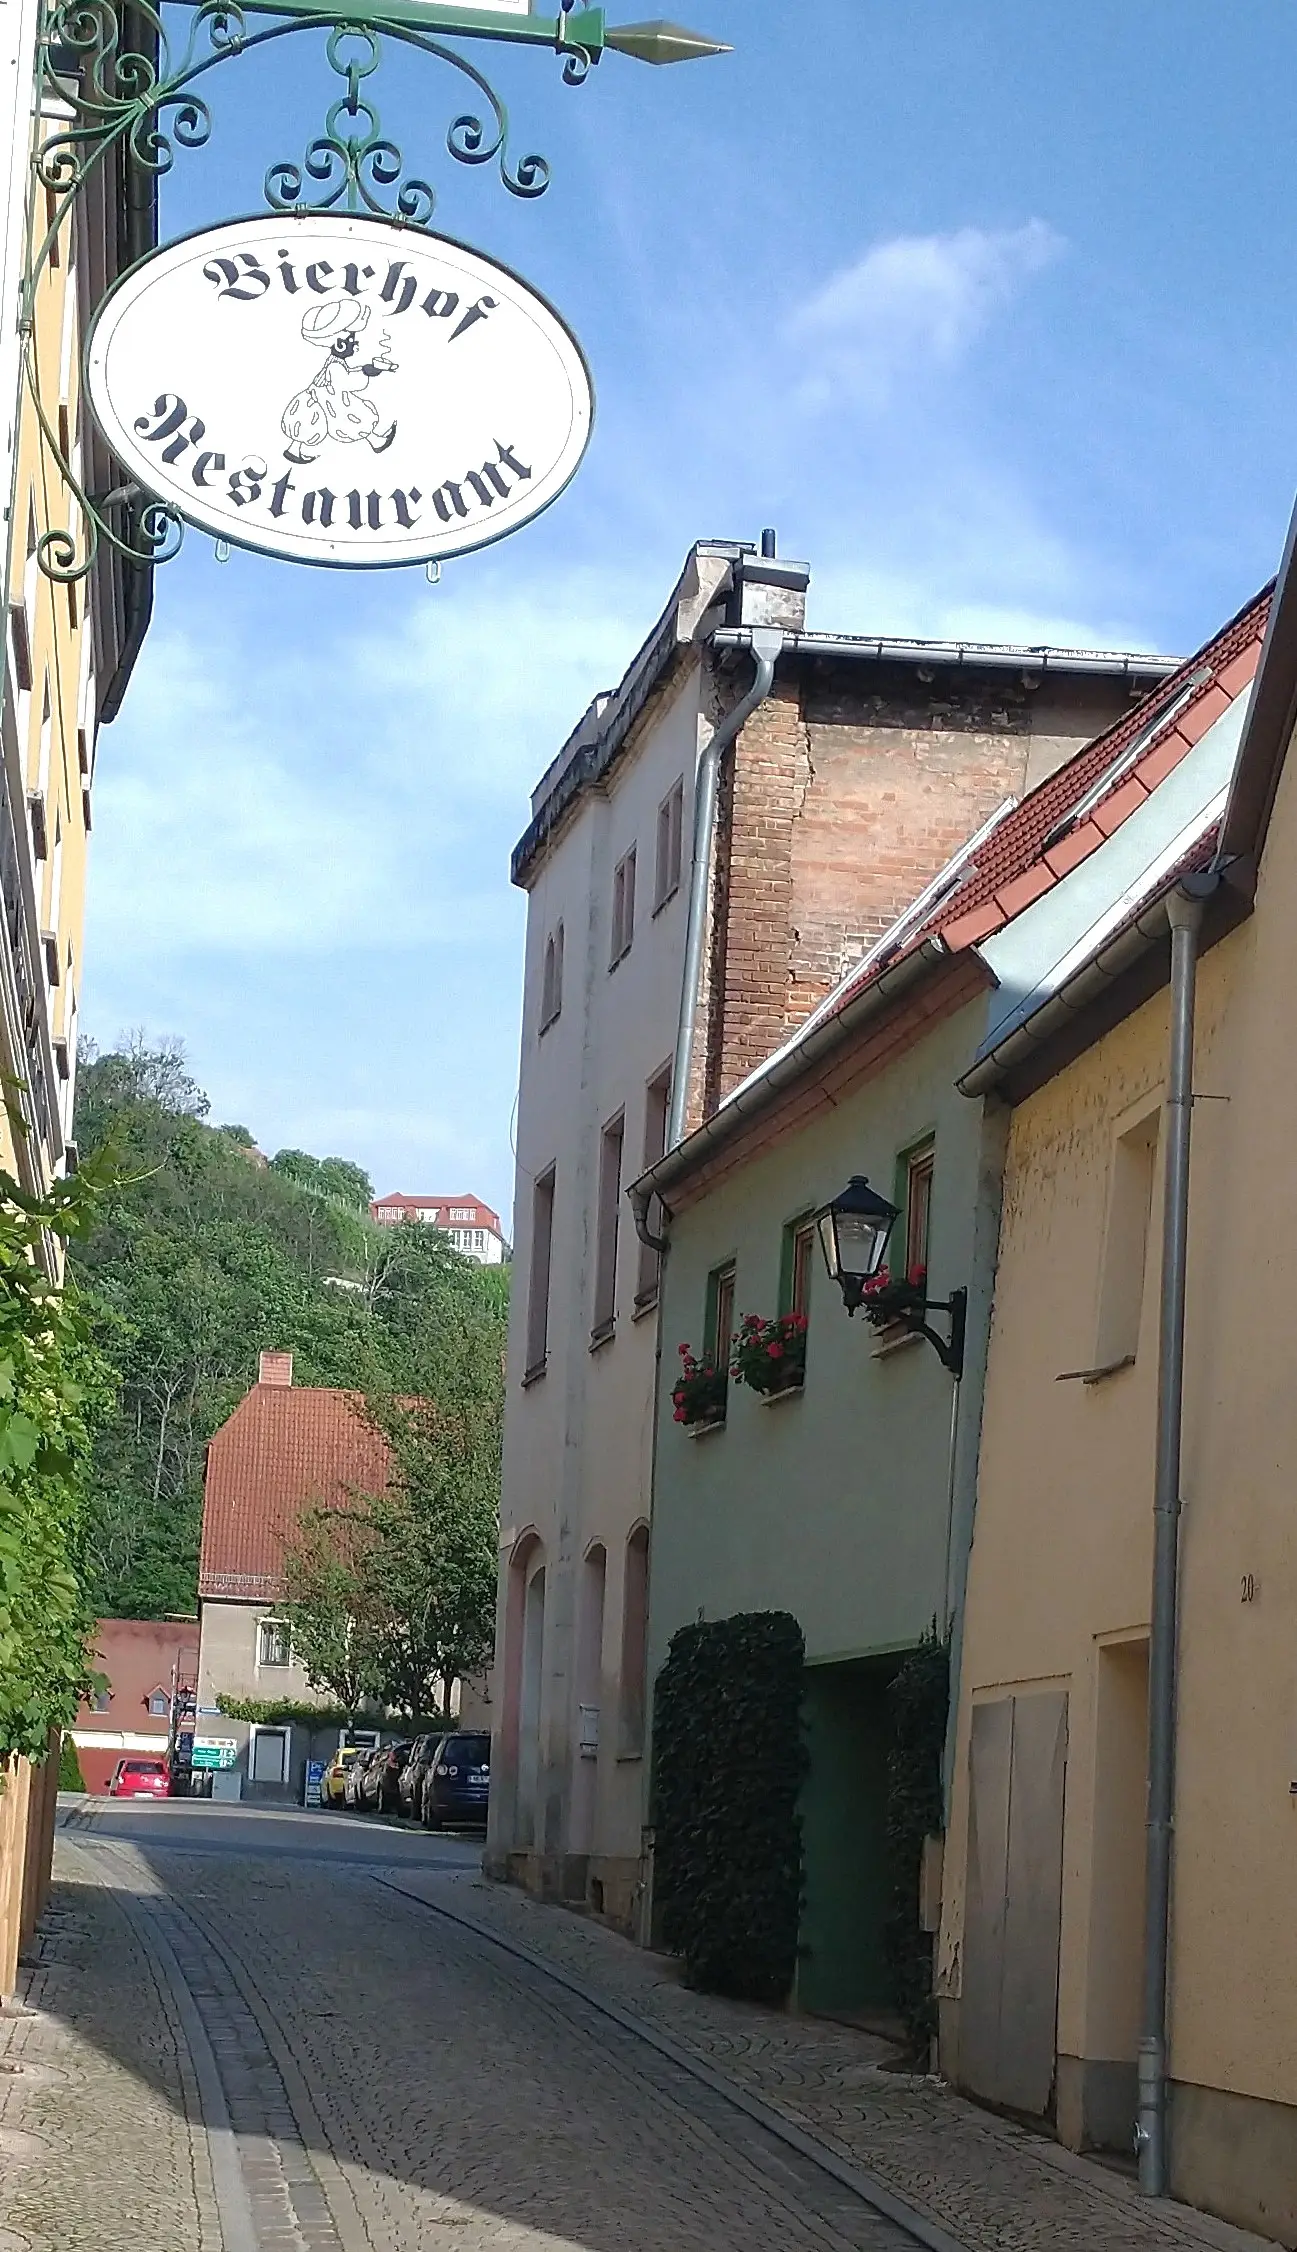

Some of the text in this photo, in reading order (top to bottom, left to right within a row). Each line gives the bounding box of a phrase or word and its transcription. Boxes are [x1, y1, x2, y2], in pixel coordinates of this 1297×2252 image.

[203, 249, 500, 343] Bierhof
[134, 394, 533, 530] Restaurant
[1241, 1574, 1254, 1603] 20
